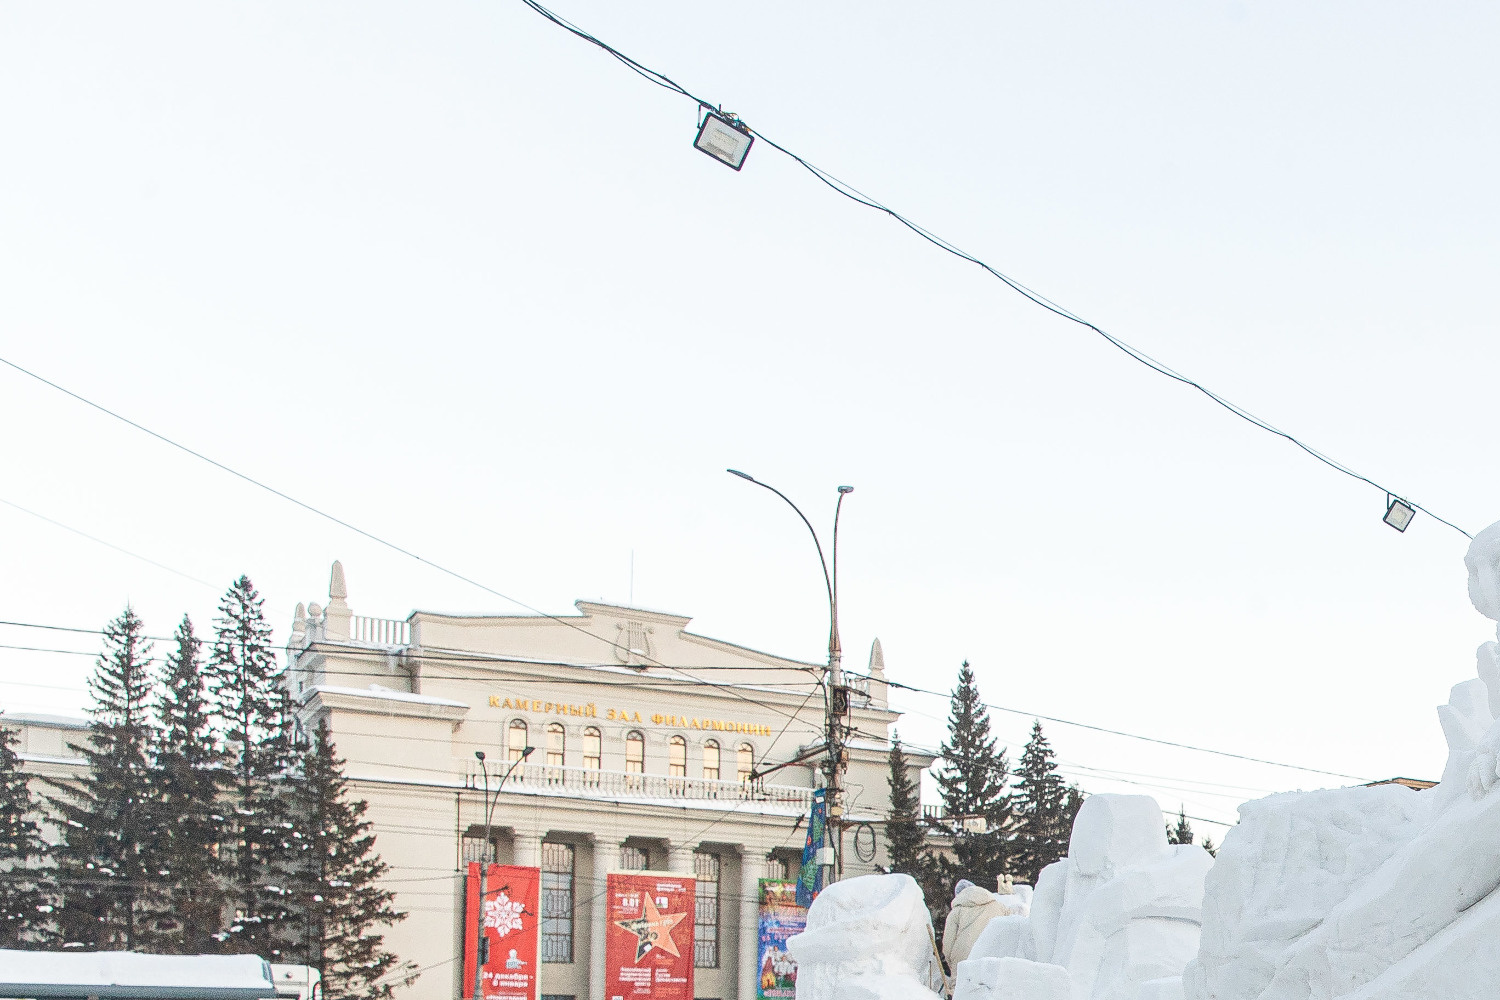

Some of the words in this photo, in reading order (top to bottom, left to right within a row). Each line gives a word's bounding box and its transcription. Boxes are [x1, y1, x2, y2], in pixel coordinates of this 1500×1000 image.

[488, 695, 597, 718] КАМЕРНЫЙ
[606, 708, 643, 724] ЗАЛ
[651, 713, 771, 736] ФИЛАРМОНИИ
